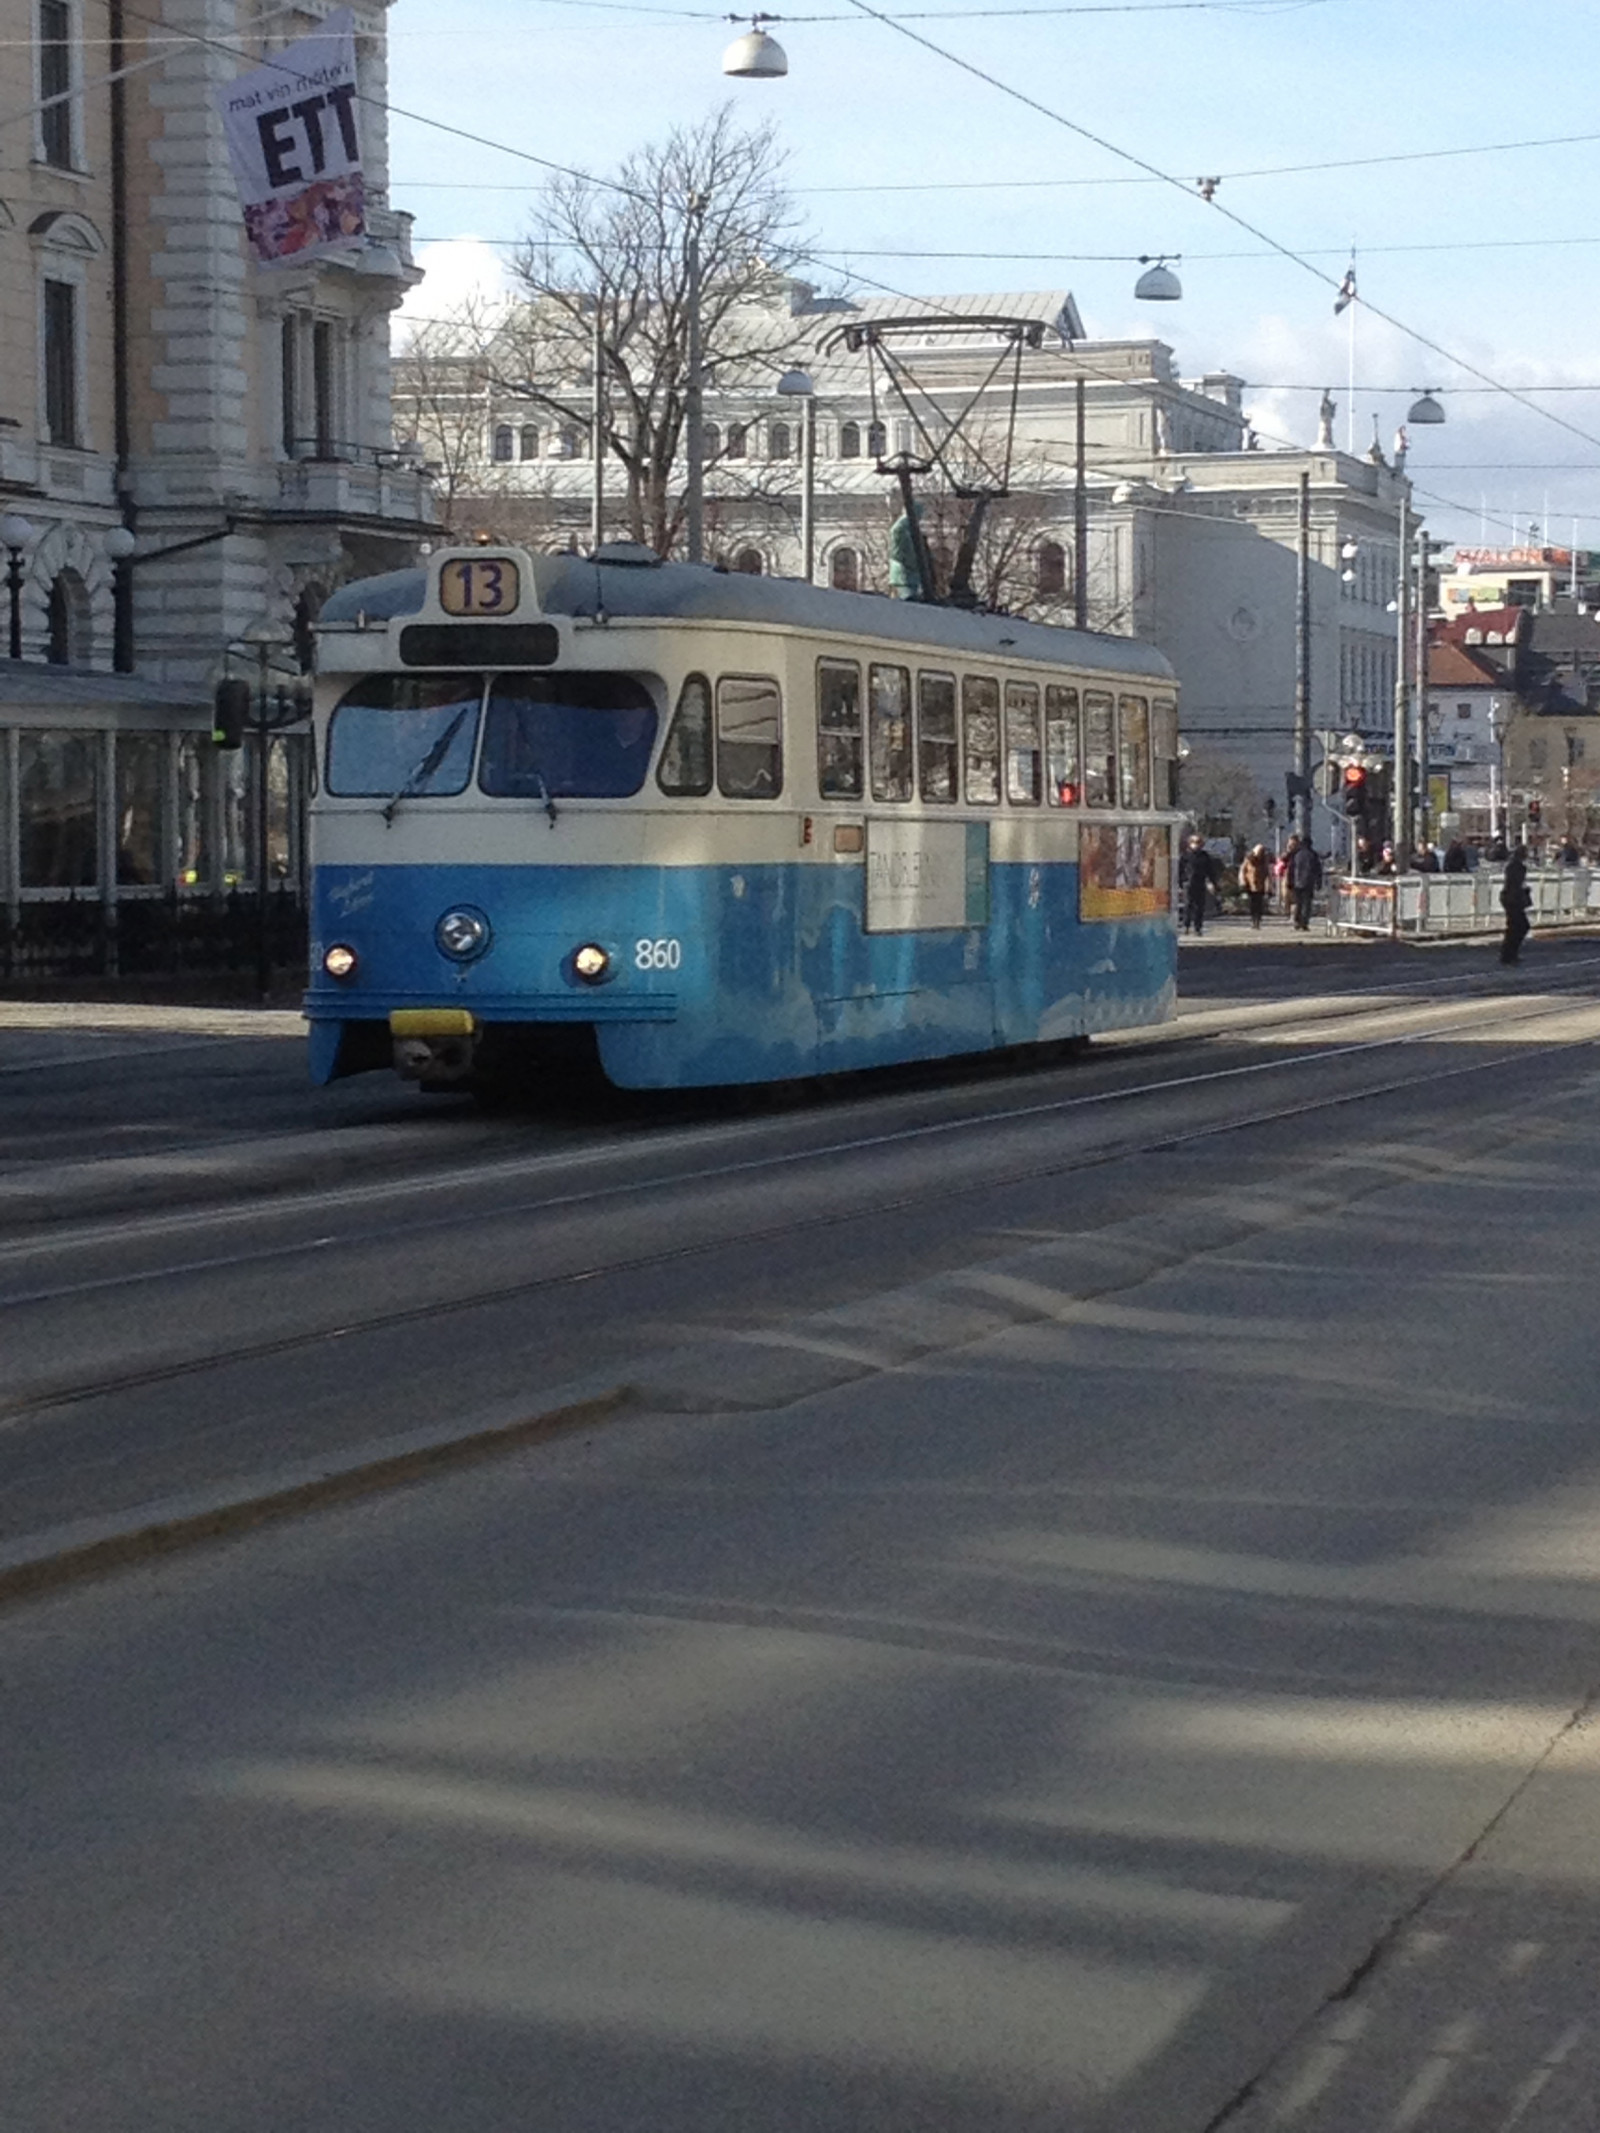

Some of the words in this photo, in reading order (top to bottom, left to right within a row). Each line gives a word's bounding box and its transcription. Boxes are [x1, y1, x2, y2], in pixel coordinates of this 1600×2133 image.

[229, 90, 262, 112] mat
[266, 81, 291, 101] vin
[256, 82, 359, 189] ETT
[456, 562, 504, 609] 13
[635, 938, 681, 969] 860
